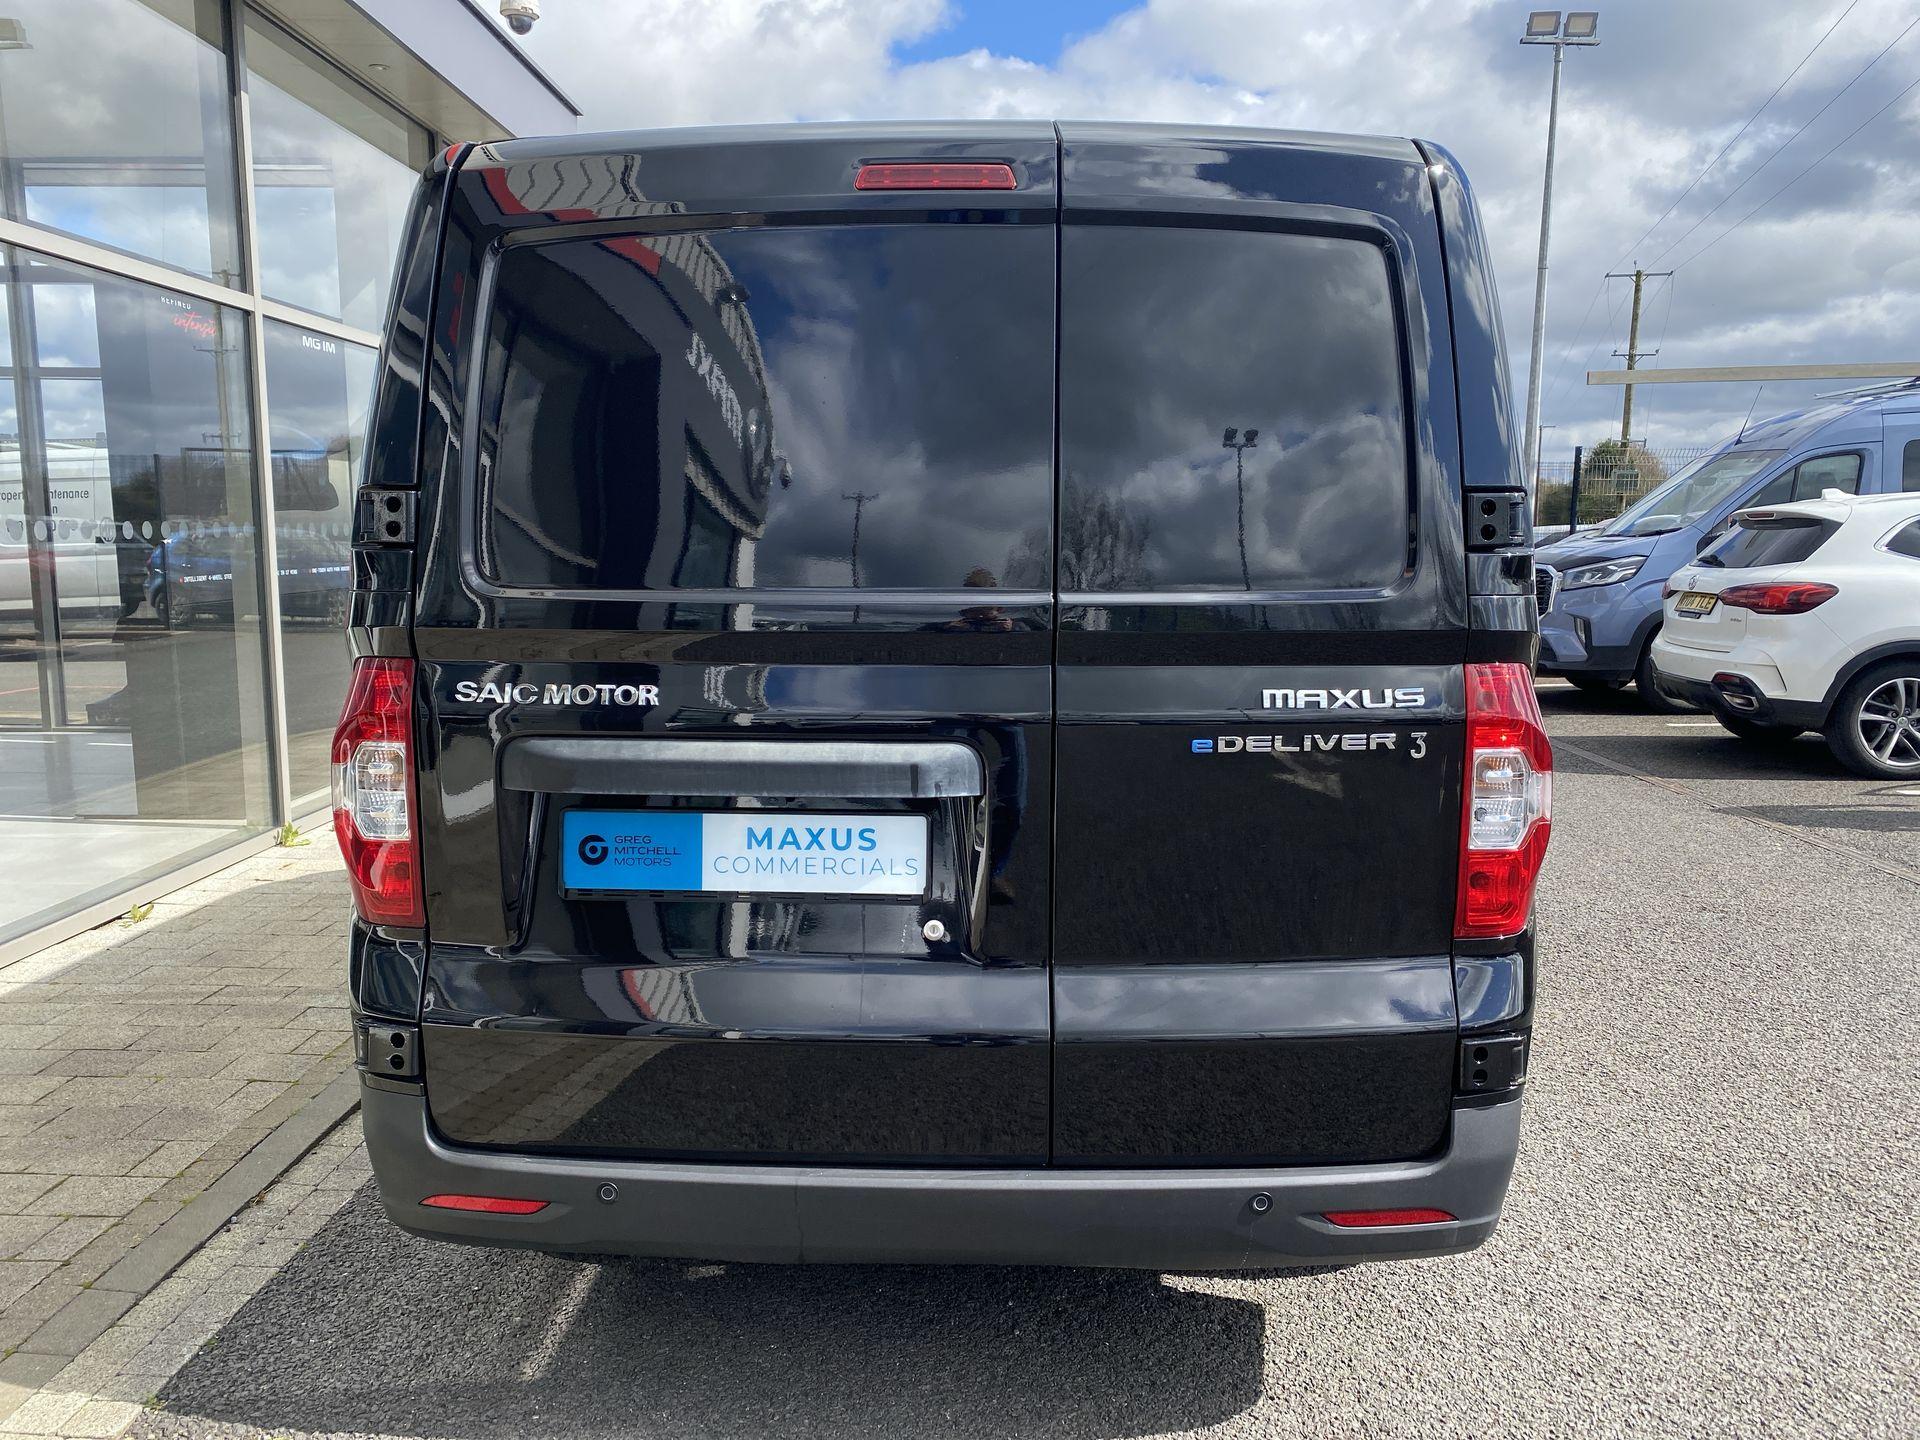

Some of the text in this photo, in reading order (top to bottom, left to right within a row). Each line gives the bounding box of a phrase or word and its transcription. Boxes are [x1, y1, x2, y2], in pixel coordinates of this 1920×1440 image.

[302, 335, 336, 355] MG IM
[454, 681, 660, 706] SAIC MOTOR
[1262, 687, 1426, 709] MAXUS
[1408, 732, 1428, 759] 3
[614, 834, 652, 845] GREG
[746, 827, 878, 851] MAXUS
[614, 845, 682, 856] MITCHELL
[614, 857, 672, 867] MOTORS
[713, 855, 919, 877] COMMERCIALS
